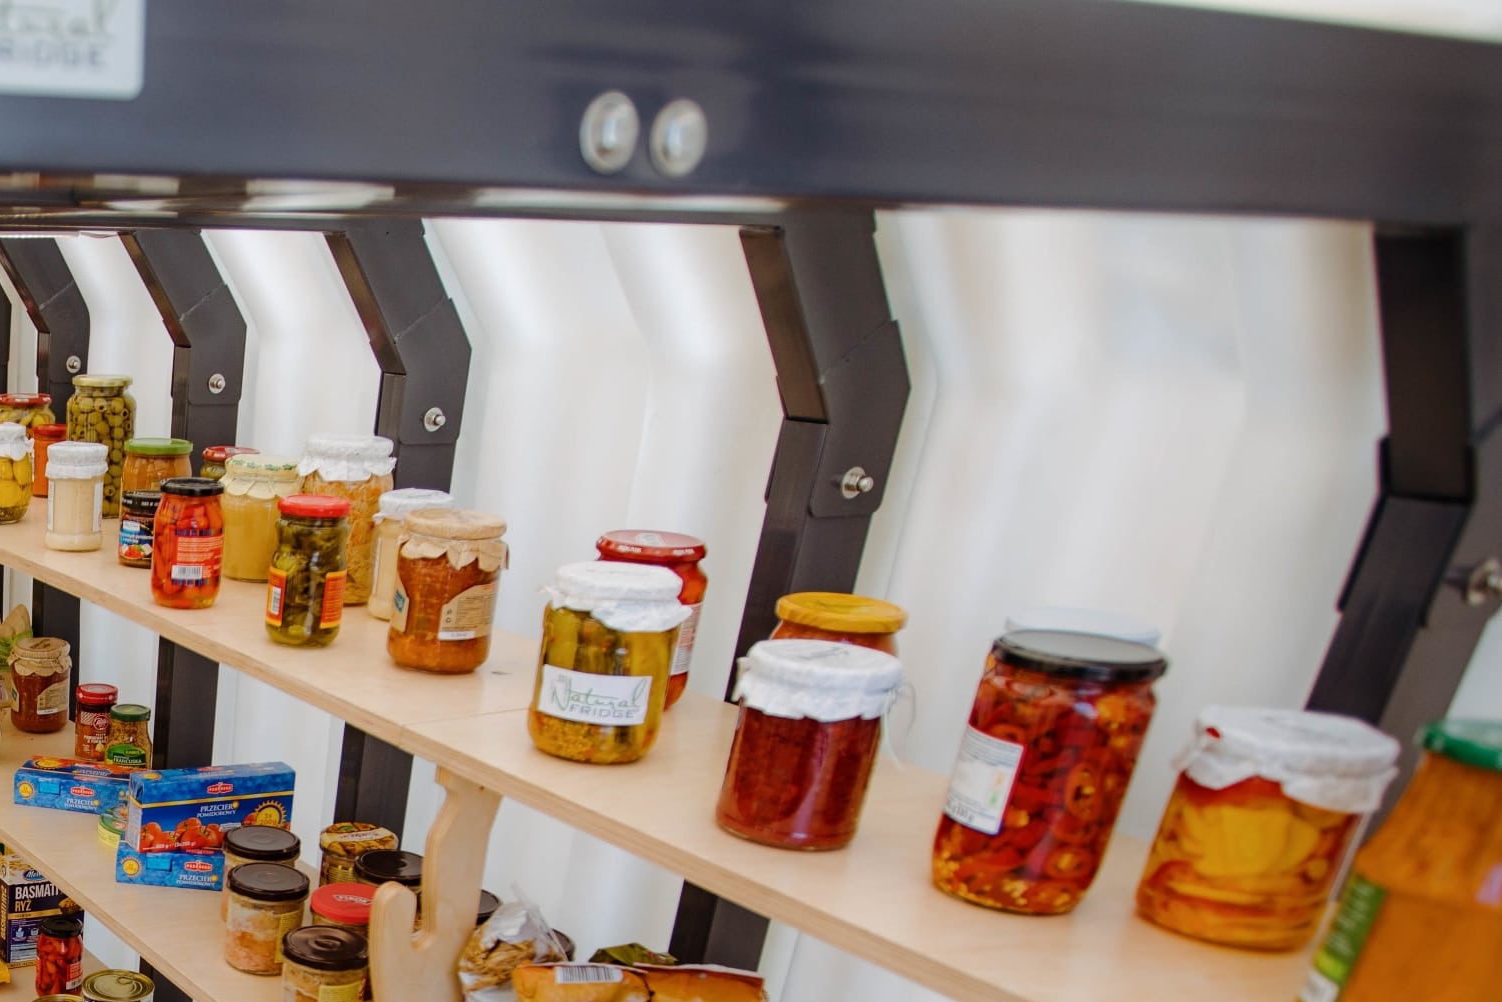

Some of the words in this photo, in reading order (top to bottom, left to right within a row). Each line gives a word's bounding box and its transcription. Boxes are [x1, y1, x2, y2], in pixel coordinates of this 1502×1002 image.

[551, 678, 648, 711] Natural
[569, 704, 639, 719] FRIDGE
[200, 803, 233, 813] PRZECIER
[14, 898, 32, 912] RYŻ
